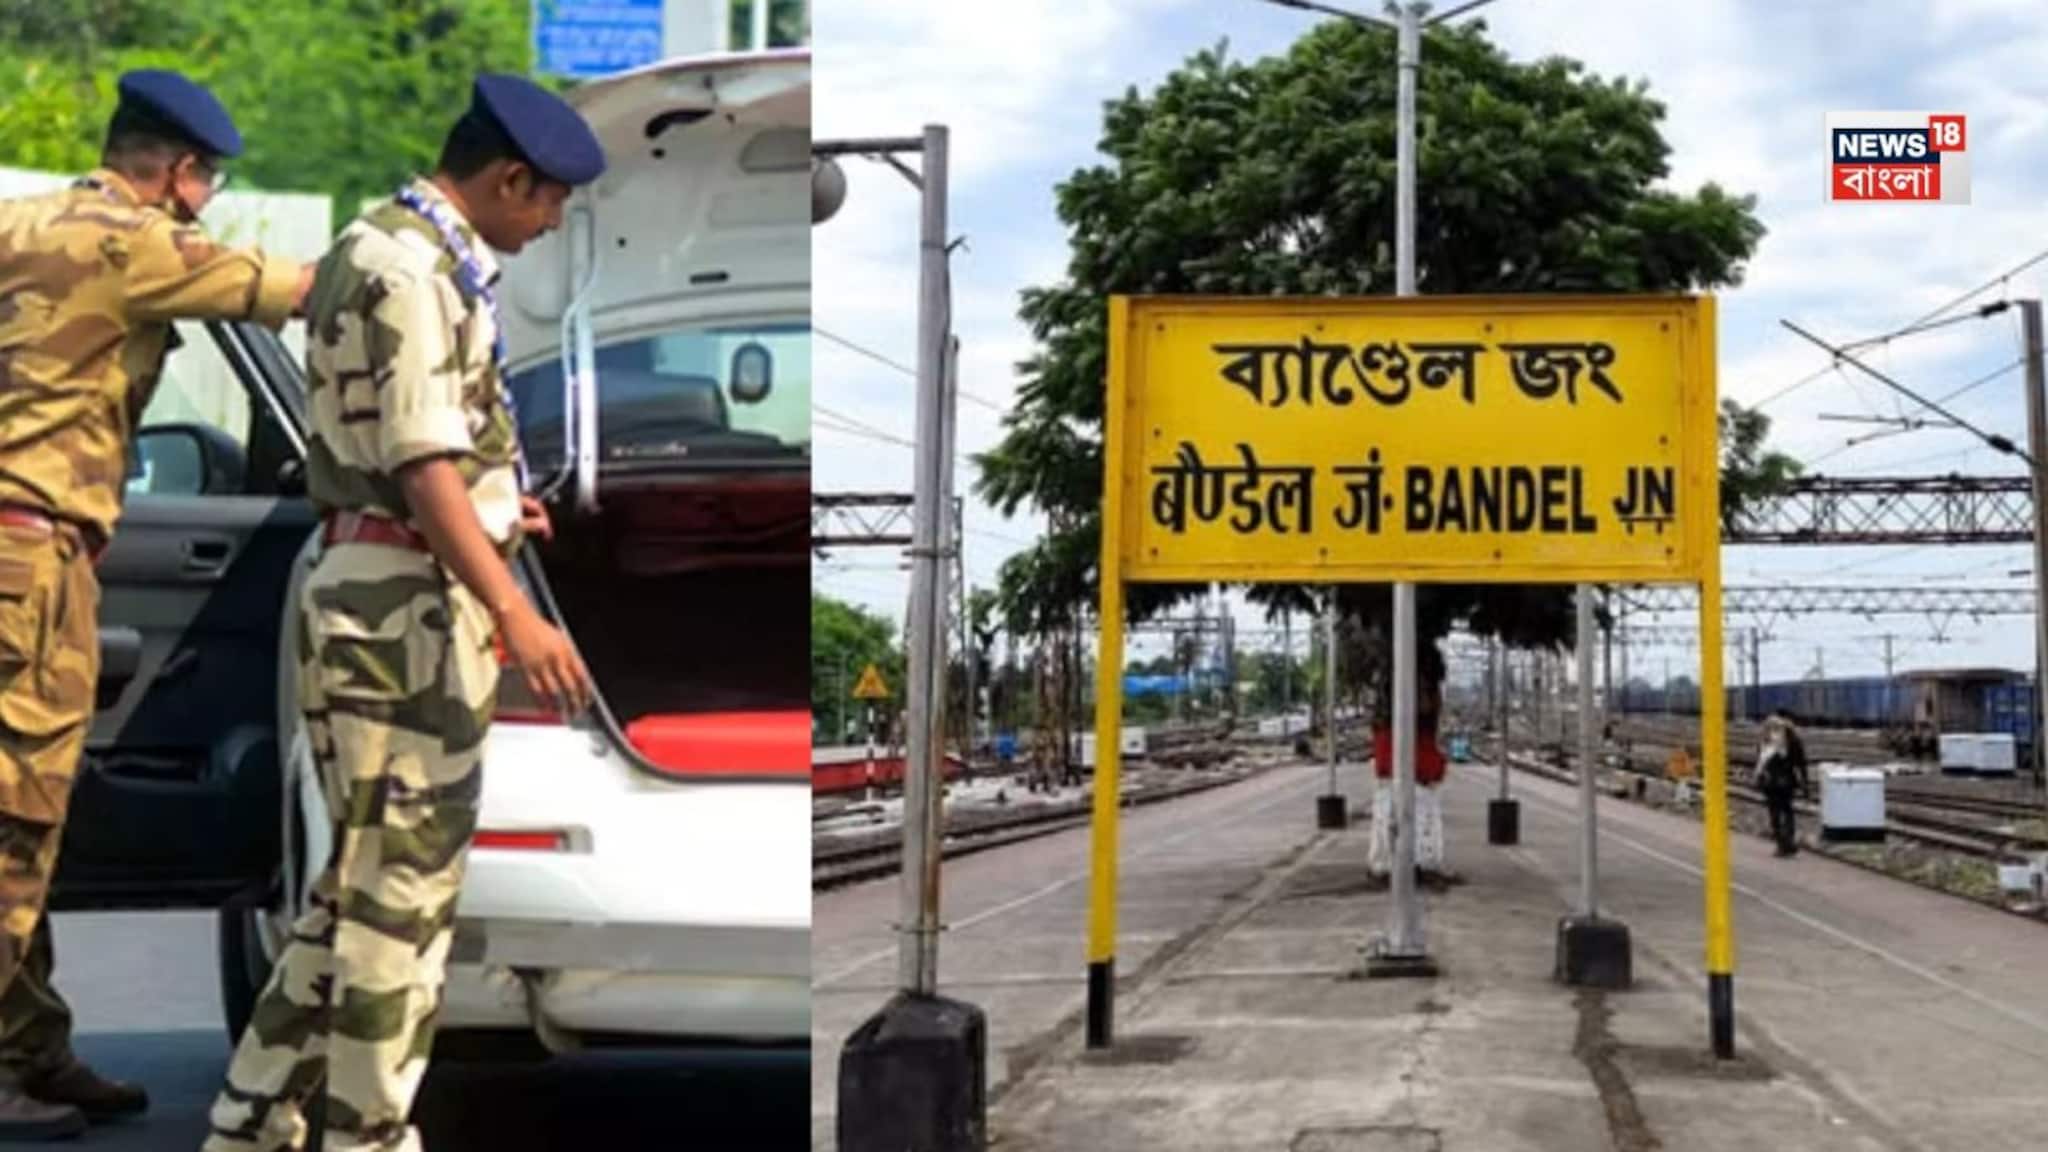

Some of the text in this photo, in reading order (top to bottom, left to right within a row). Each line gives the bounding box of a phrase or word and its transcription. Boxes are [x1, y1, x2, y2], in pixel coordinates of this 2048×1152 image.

[1211, 336, 1623, 407] ব্যাণ্ডেল জং
[1151, 442, 1315, 534] बैण्डेल
[1405, 466, 1598, 533] BANDEL
